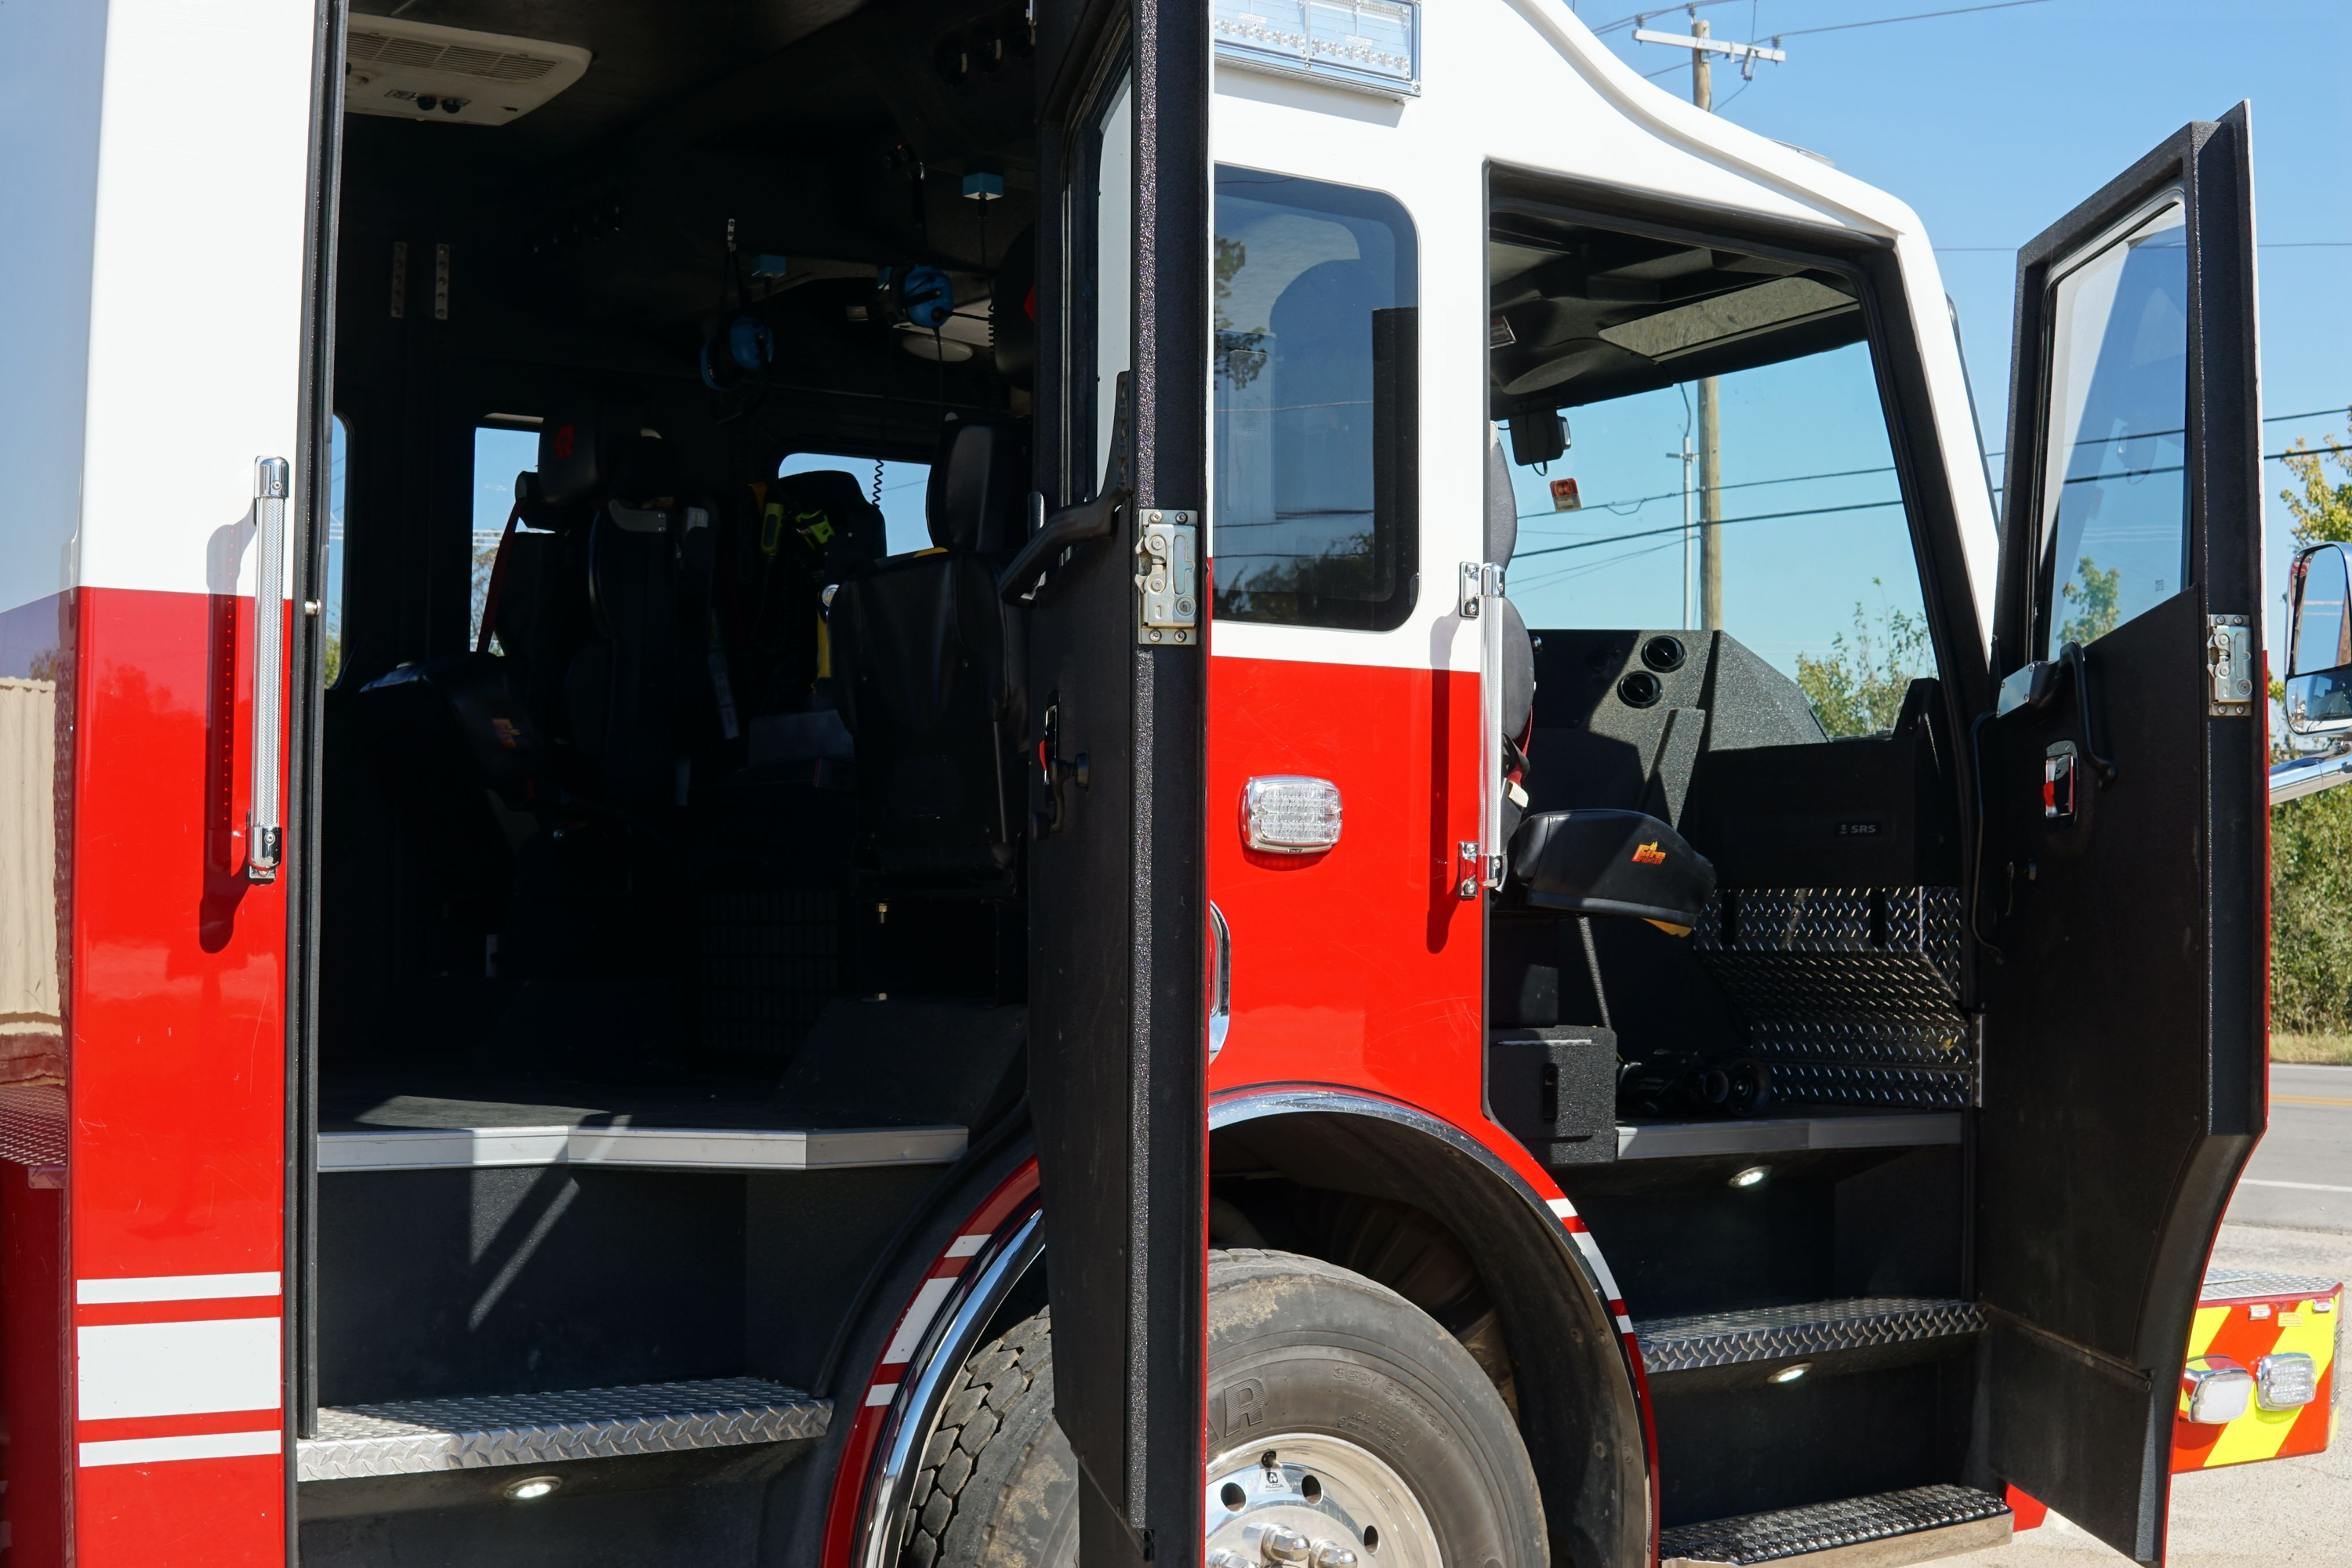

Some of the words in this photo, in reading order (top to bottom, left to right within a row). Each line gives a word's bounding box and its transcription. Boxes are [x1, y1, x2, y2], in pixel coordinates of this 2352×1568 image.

[1850, 825, 1876, 833] SRS
[1632, 841, 1666, 862] Fire
[1351, 1412, 1371, 1425] LOAD
[1377, 1421, 1400, 1441] RANGE
